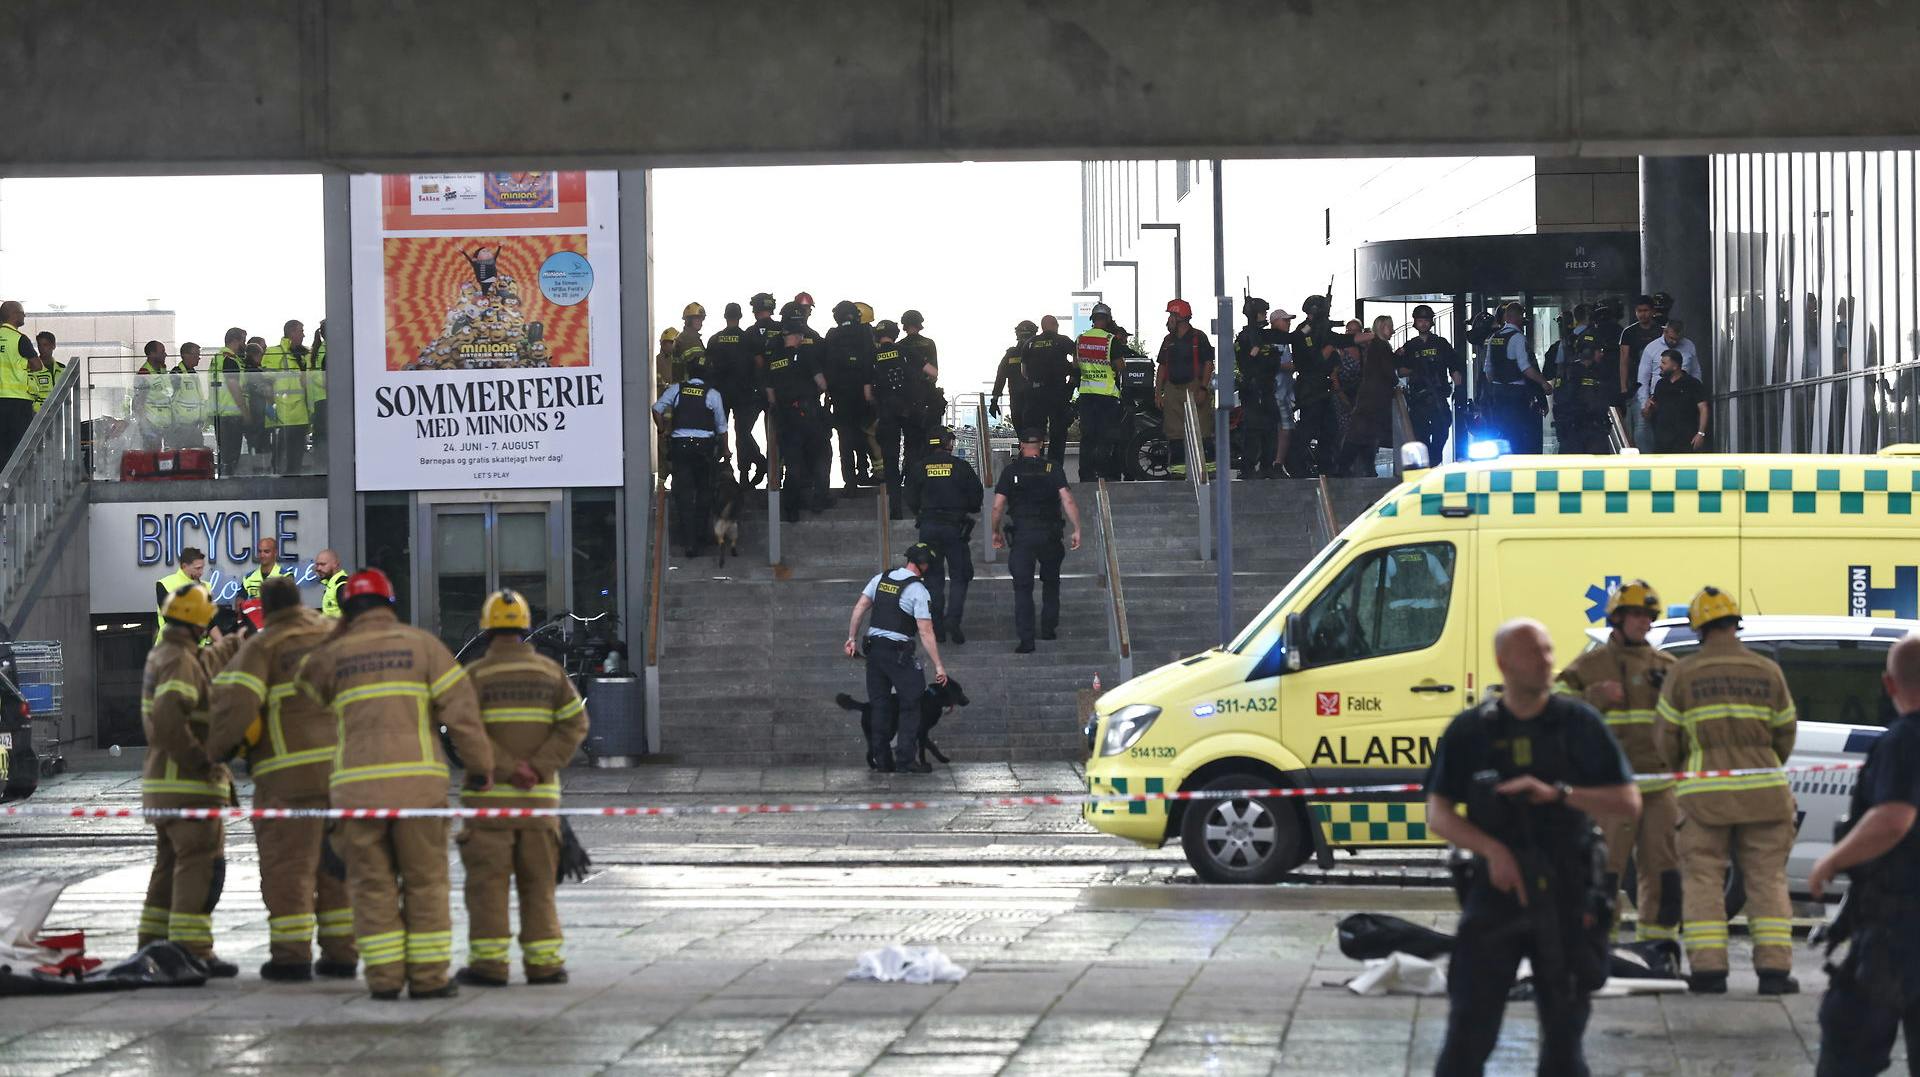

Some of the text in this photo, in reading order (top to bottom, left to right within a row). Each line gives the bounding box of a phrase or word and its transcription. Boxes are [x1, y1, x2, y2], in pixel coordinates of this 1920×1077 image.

[1370, 258, 1421, 281] OMMEN
[1565, 260, 1596, 269] FIELD'S
[374, 374, 604, 418] SOMMERFERIE
[416, 411, 566, 438] MED MINIONS 2
[443, 443, 457, 452] 24.
[460, 442, 482, 451] JUNI
[492, 442, 499, 451] 7.
[501, 441, 540, 450] AUGUST
[419, 457, 455, 465] Børnepas
[468, 456, 490, 464] gratis
[491, 455, 528, 464] skattejagt
[547, 454, 564, 463] dag!
[137, 510, 299, 566] BICYCLE
[1852, 568, 1867, 618] EGION
[1216, 696, 1278, 714] 511-A32
[1346, 695, 1382, 711] Falck
[1130, 746, 1177, 758] 5141320
